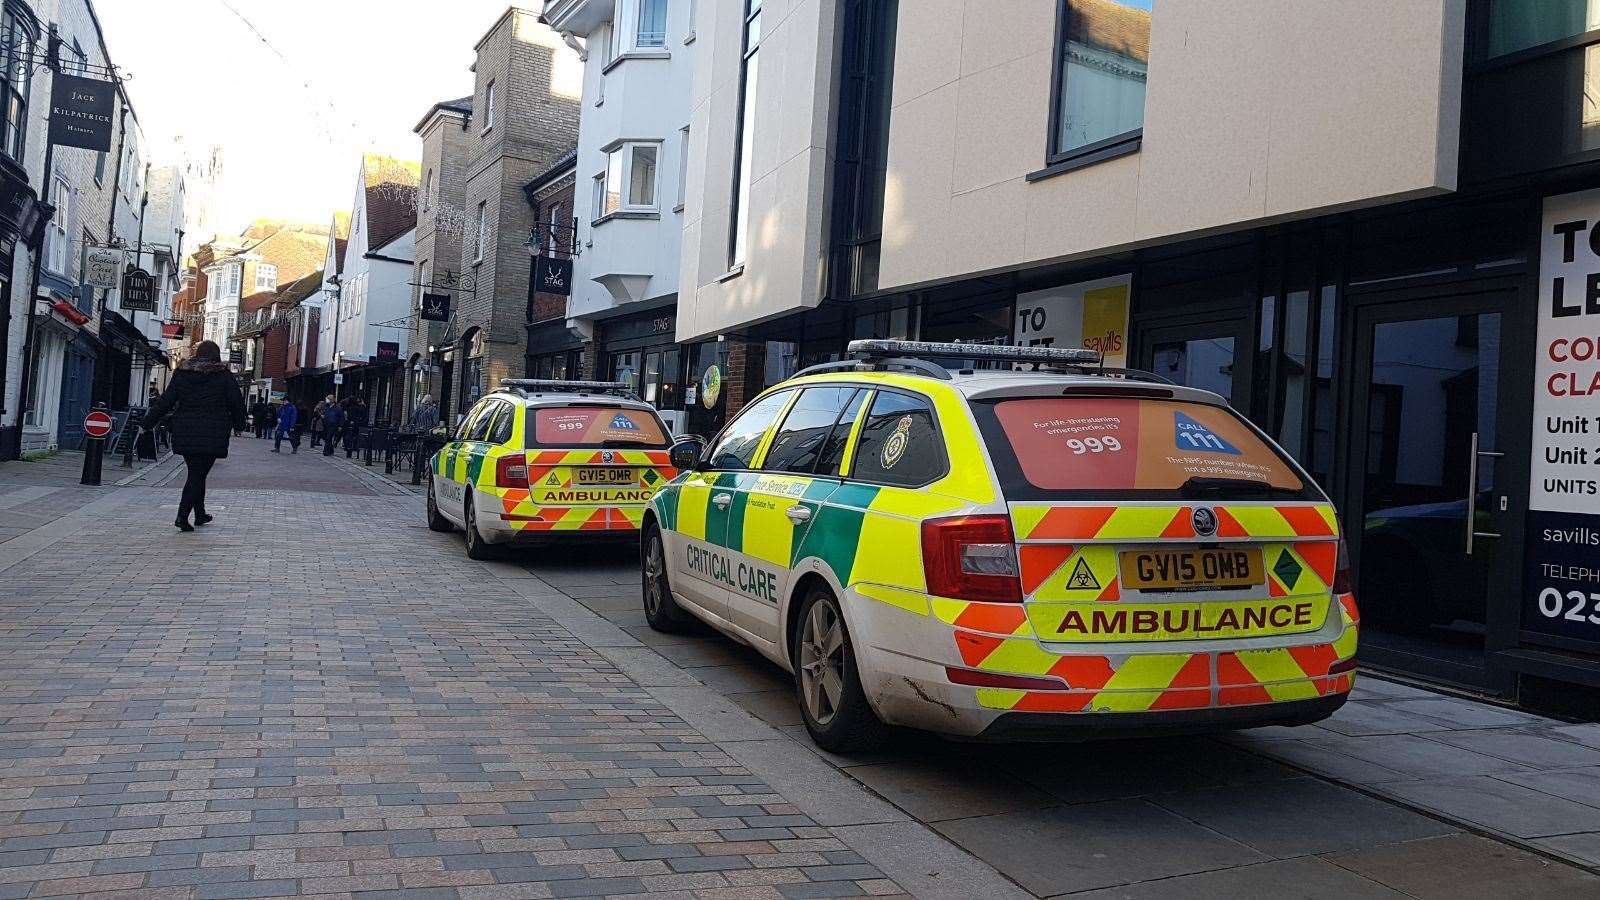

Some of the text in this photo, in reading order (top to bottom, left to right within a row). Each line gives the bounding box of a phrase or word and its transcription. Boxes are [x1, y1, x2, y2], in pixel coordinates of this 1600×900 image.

[544, 276, 564, 286] STAG
[1019, 307, 1046, 333] TO
[1083, 330, 1122, 352] savills
[1548, 336, 1600, 363] CO
[558, 422, 584, 430] 999
[613, 420, 633, 429] 111
[1177, 423, 1208, 432] CALL
[1546, 416, 1588, 433] Unit
[1066, 435, 1122, 455] 999
[1179, 431, 1225, 450] 111
[1545, 446, 1587, 464] Unit
[1544, 478, 1597, 494] UNITS
[1543, 528, 1599, 545] savills
[686, 543, 778, 604] CRITICAL CARE
[1137, 551, 1251, 582] GV15 OMB
[1541, 563, 1600, 583] TELEPH
[1055, 603, 1313, 635] AMBULANCE
